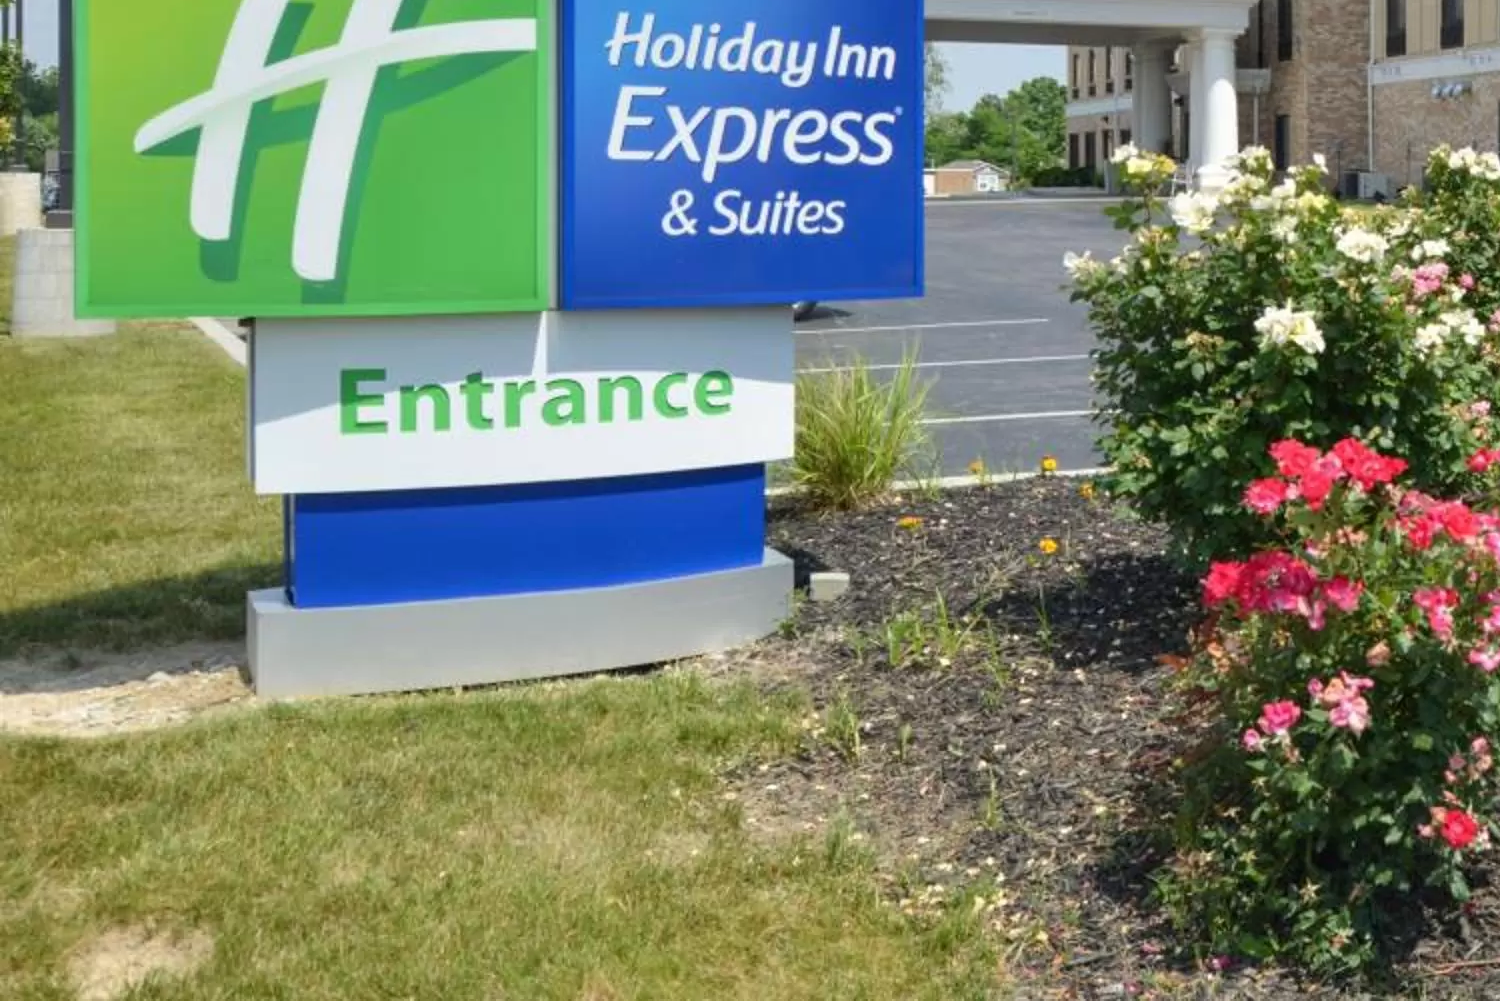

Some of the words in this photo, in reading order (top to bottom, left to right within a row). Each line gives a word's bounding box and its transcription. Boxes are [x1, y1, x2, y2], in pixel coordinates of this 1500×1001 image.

[605, 12, 816, 87] Holiday
[823, 26, 896, 79] Inn
[607, 85, 897, 183] Express
[661, 189, 698, 236] &
[709, 190, 847, 235] Suites
[340, 369, 734, 434] Entrance
